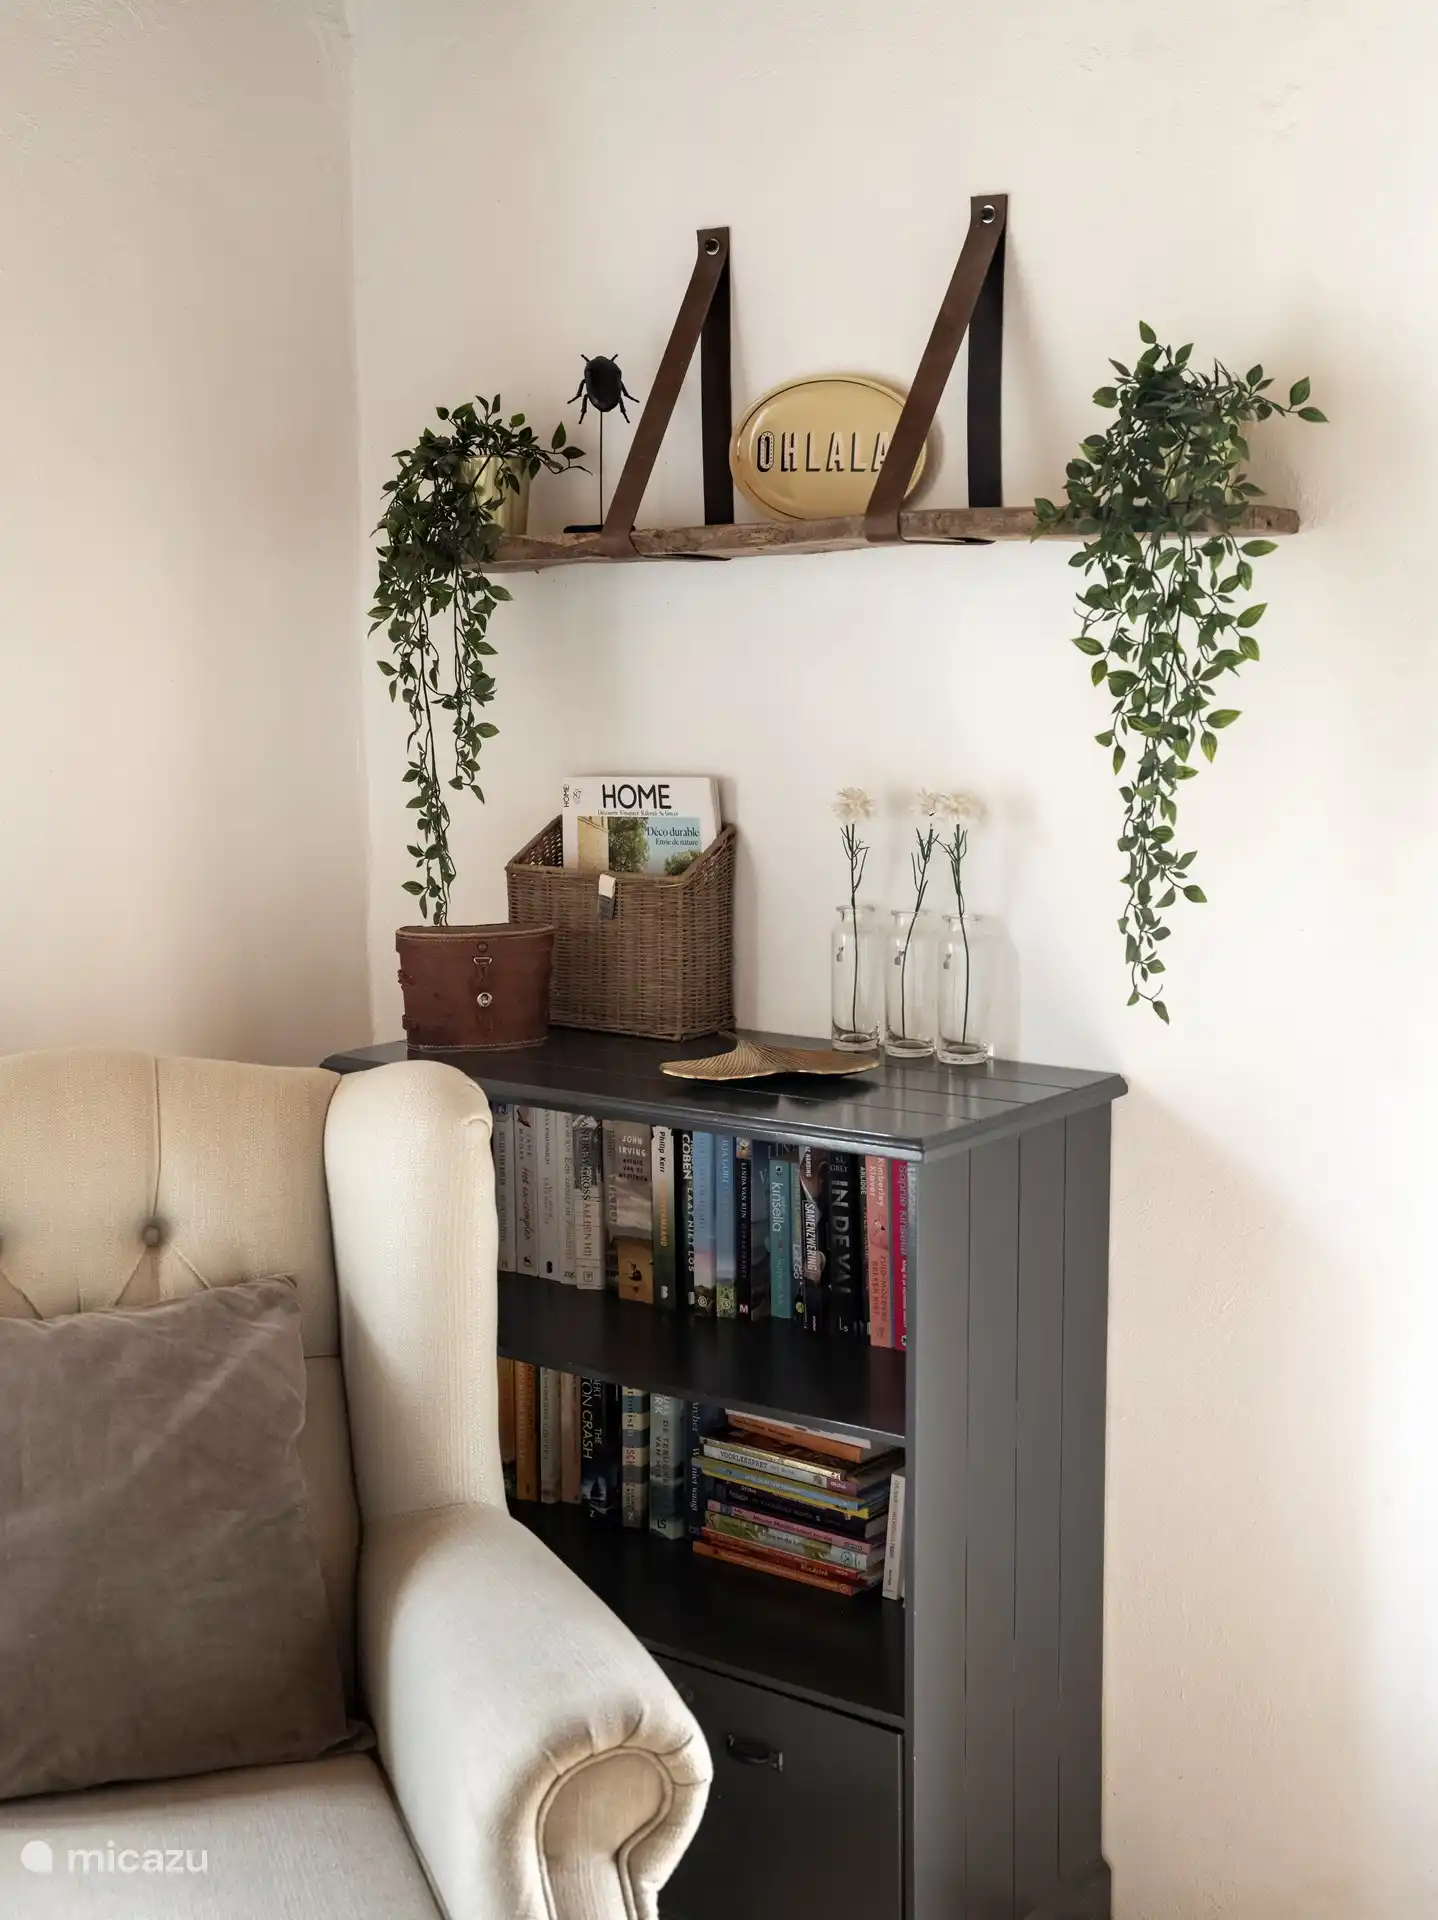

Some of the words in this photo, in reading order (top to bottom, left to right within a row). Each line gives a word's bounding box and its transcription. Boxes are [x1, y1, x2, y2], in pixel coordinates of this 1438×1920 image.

[757, 431, 891, 472] OHLALA
[562, 783, 570, 808] HOME
[602, 784, 672, 809] HOME
[647, 825, 668, 838] Déco
[669, 826, 700, 838] durable
[655, 838, 671, 846] Envie
[672, 838, 680, 846] de
[680, 838, 699, 846] nature
[619, 1146, 647, 1157] IRVING
[622, 1136, 643, 1145] JOHN
[659, 1131, 667, 1154] Philip
[659, 1156, 667, 1174] Kerr
[682, 1133, 694, 1180] COBEN
[580, 1167, 591, 1201] GROSS
[831, 1180, 850, 1208] IN
[875, 1157, 885, 1208] Kimberley
[771, 1182, 785, 1232] kinsella
[804, 1202, 817, 1271] SAMENZWERING
[831, 1215, 850, 1248] DE
[581, 1409, 594, 1460] CRASH
[593, 1427, 604, 1445] THE
[719, 1450, 768, 1469] VOORLEESPRET
[691, 1467, 700, 1485] niet
